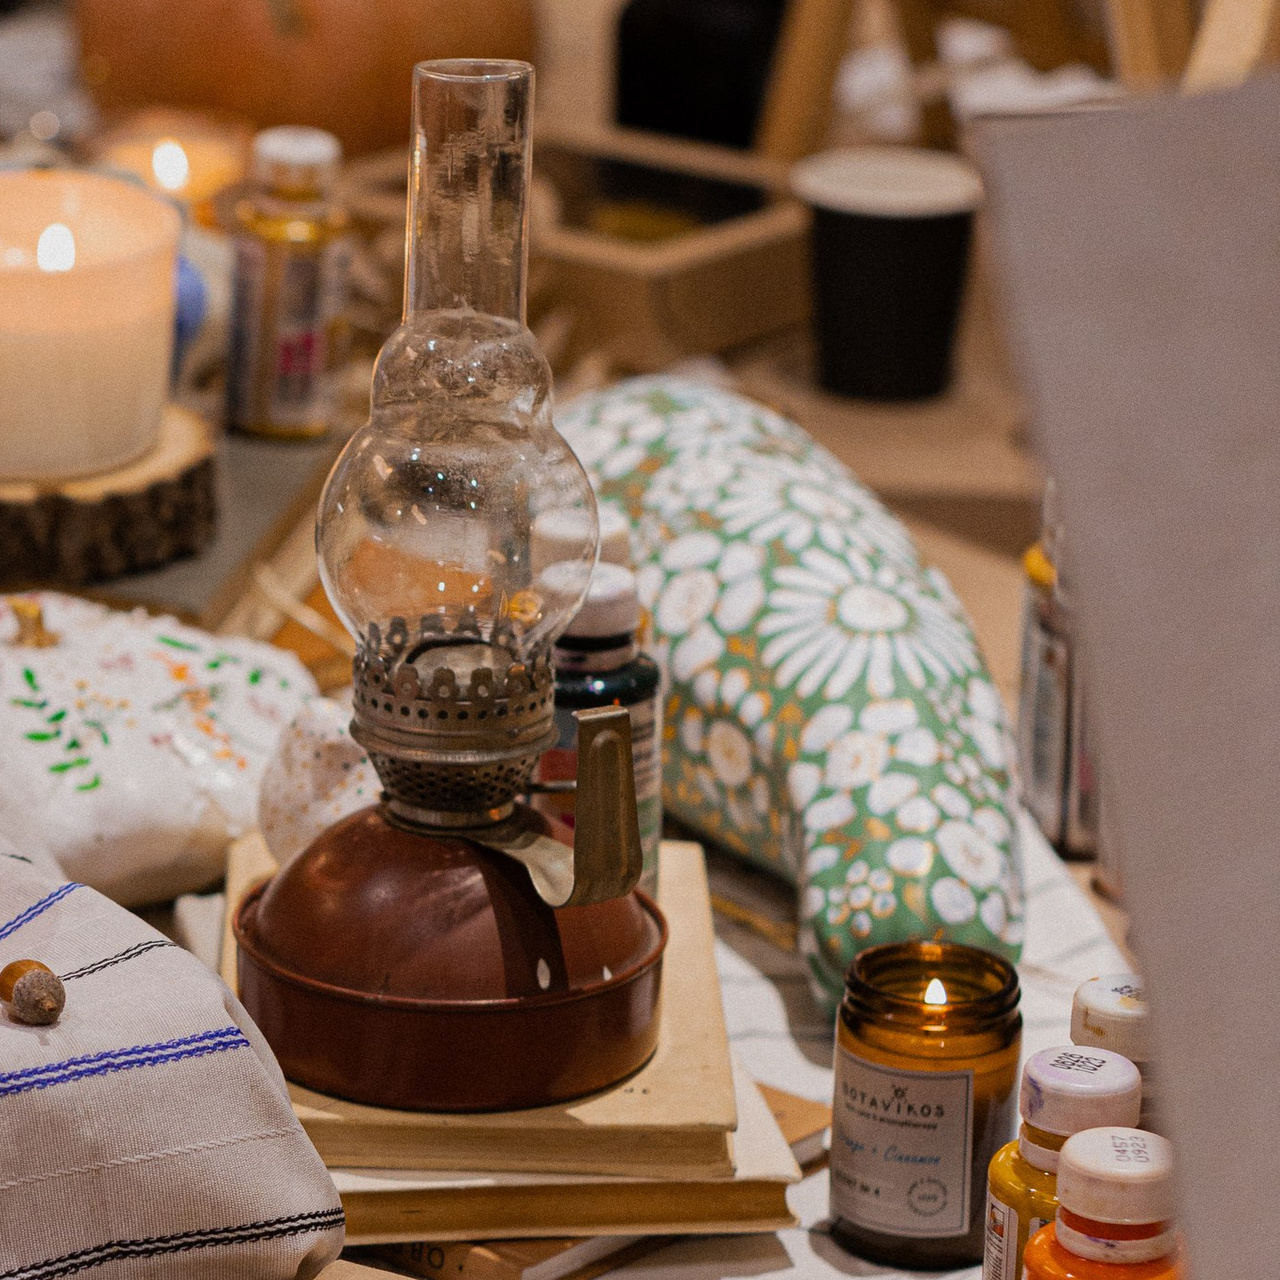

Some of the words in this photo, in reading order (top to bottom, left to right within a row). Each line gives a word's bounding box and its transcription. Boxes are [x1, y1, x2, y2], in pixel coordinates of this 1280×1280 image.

[1073, 1056, 1107, 1075] 1023
[1111, 1135, 1131, 1162] 0457
[1129, 1136, 1150, 1163] 0923
